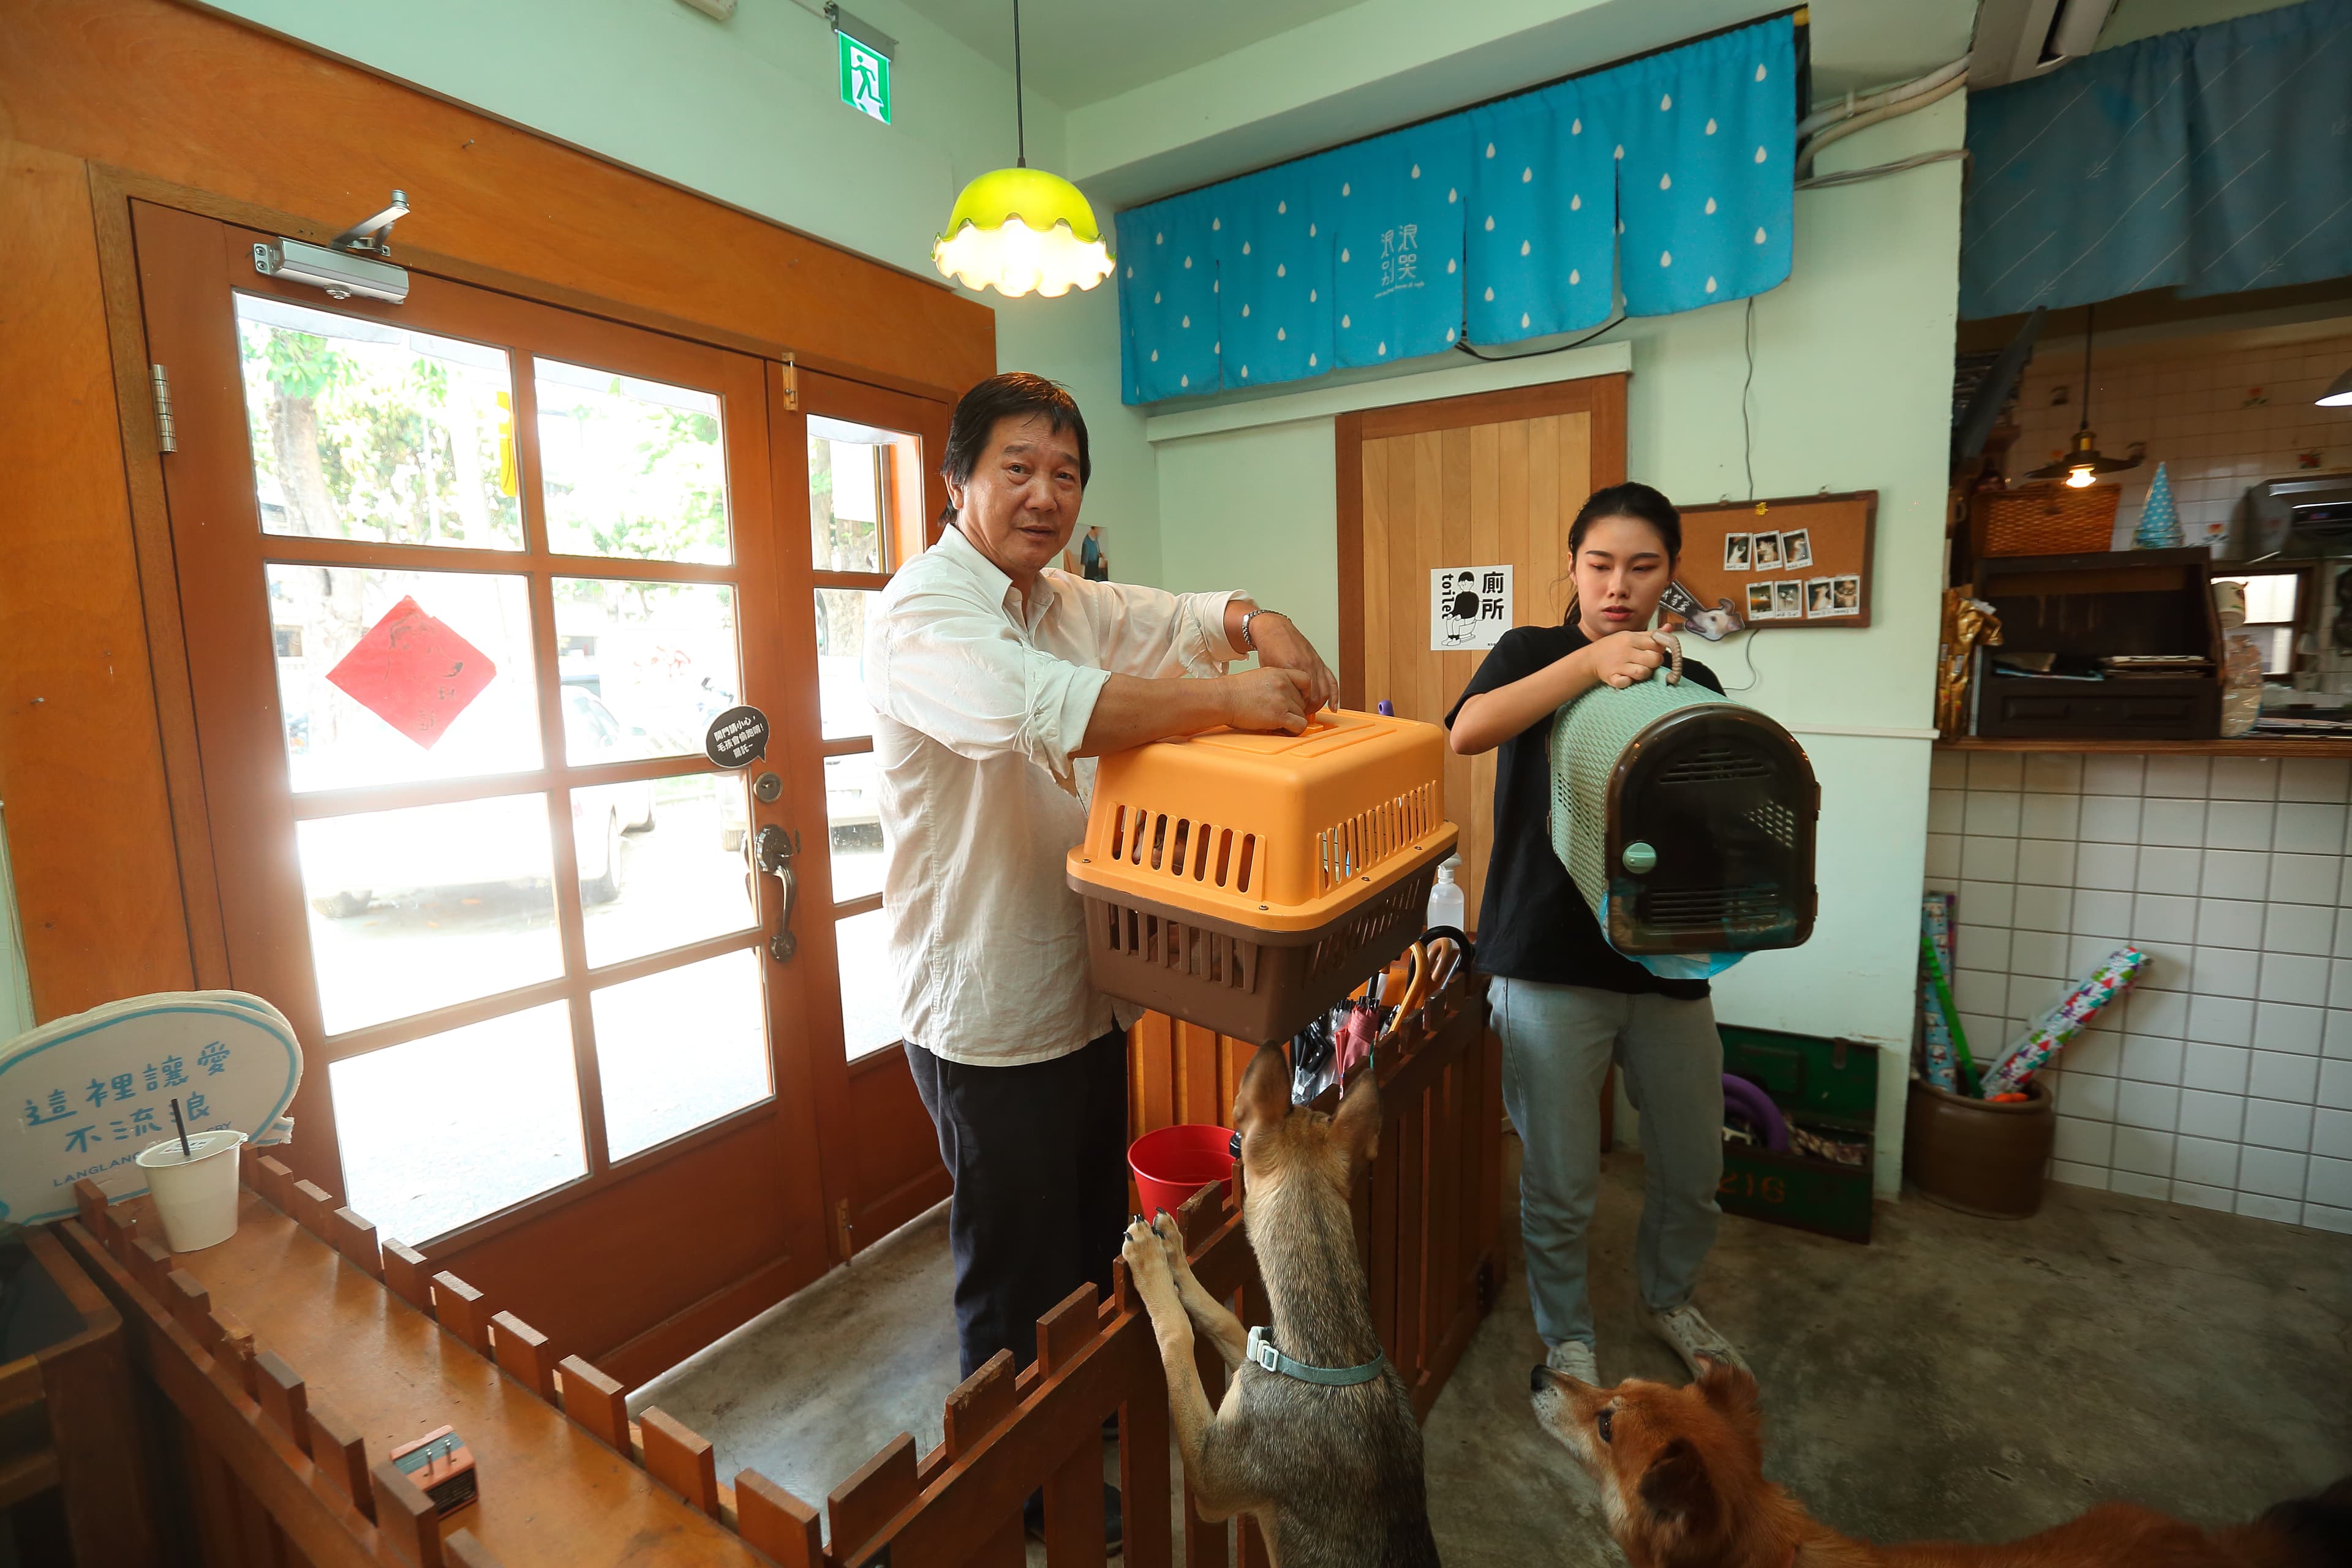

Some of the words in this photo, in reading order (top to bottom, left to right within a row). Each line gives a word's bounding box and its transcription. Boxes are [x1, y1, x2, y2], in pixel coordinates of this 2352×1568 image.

[1482, 571, 1504, 620] 廁所
[24, 1040, 231, 1126] 這裡讓愛
[64, 1090, 211, 1153] 不流浪
